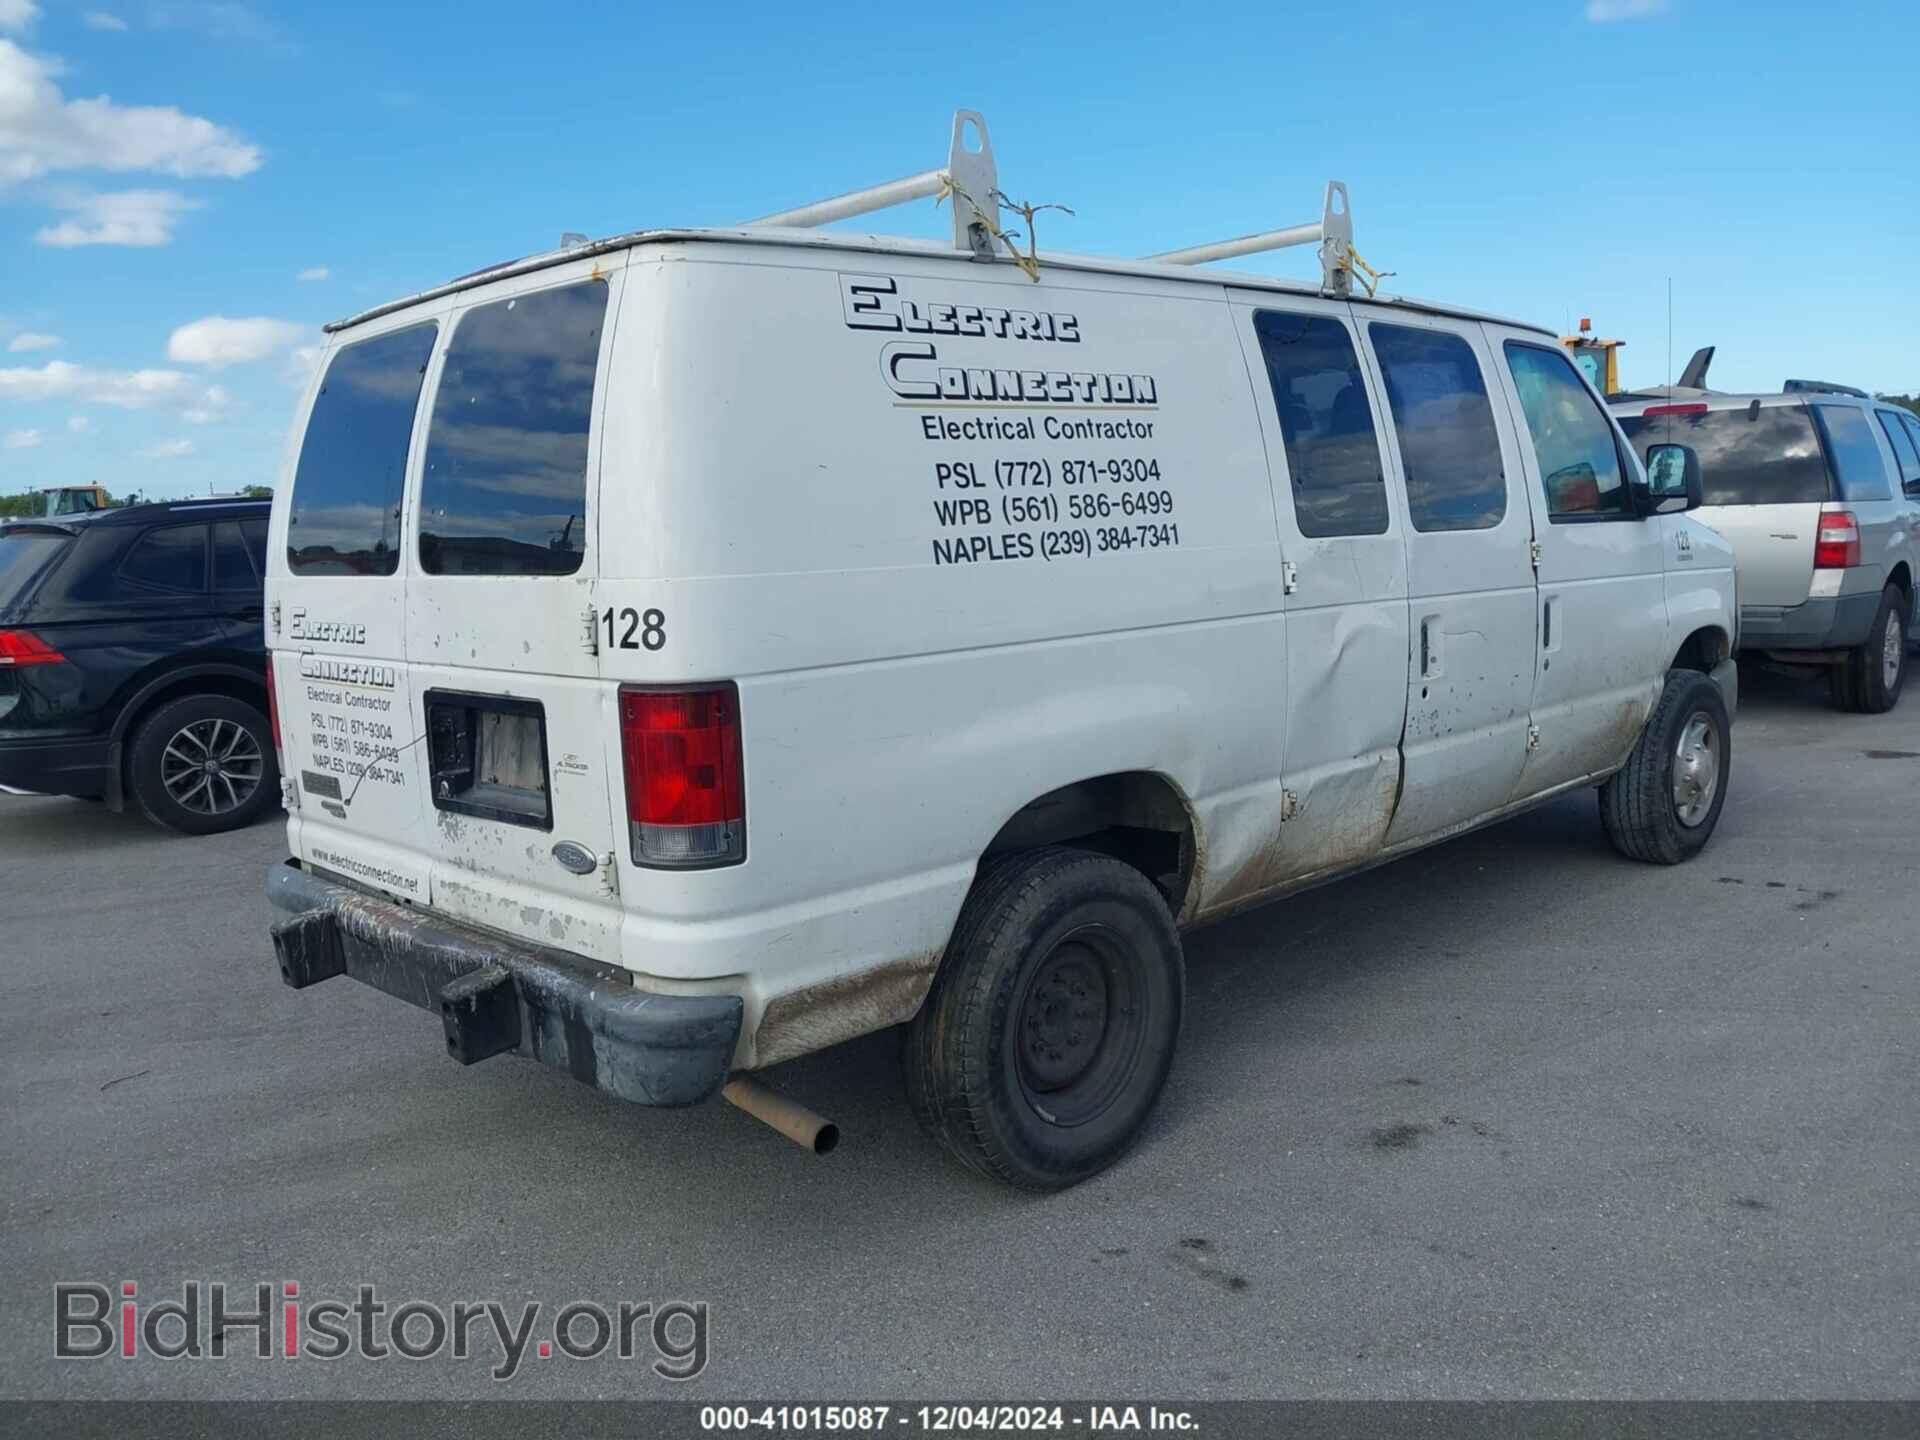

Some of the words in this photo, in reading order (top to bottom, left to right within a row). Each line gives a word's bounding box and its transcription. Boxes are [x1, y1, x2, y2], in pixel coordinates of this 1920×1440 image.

[921, 415, 1036, 440] Electrical
[1043, 416, 1154, 440] Contractor
[935, 463, 986, 489] PSL
[994, 458, 1052, 489] (772)
[1062, 459, 1161, 485] 871-9304
[934, 499, 992, 527] WPB
[1002, 494, 1059, 525] (561)
[1069, 490, 1174, 519] 586-6499
[932, 533, 1035, 565] NAPLES
[1039, 529, 1093, 561] (239)
[1097, 523, 1180, 551] 384-7341
[602, 607, 667, 651] 128
[306, 686, 343, 704] Electrical
[344, 691, 391, 712] Contractor
[311, 711, 327, 730] PSL
[351, 719, 393, 741] 871-9304
[312, 753, 346, 774] NAPLES
[311, 848, 418, 893] www.electricconnection.net
